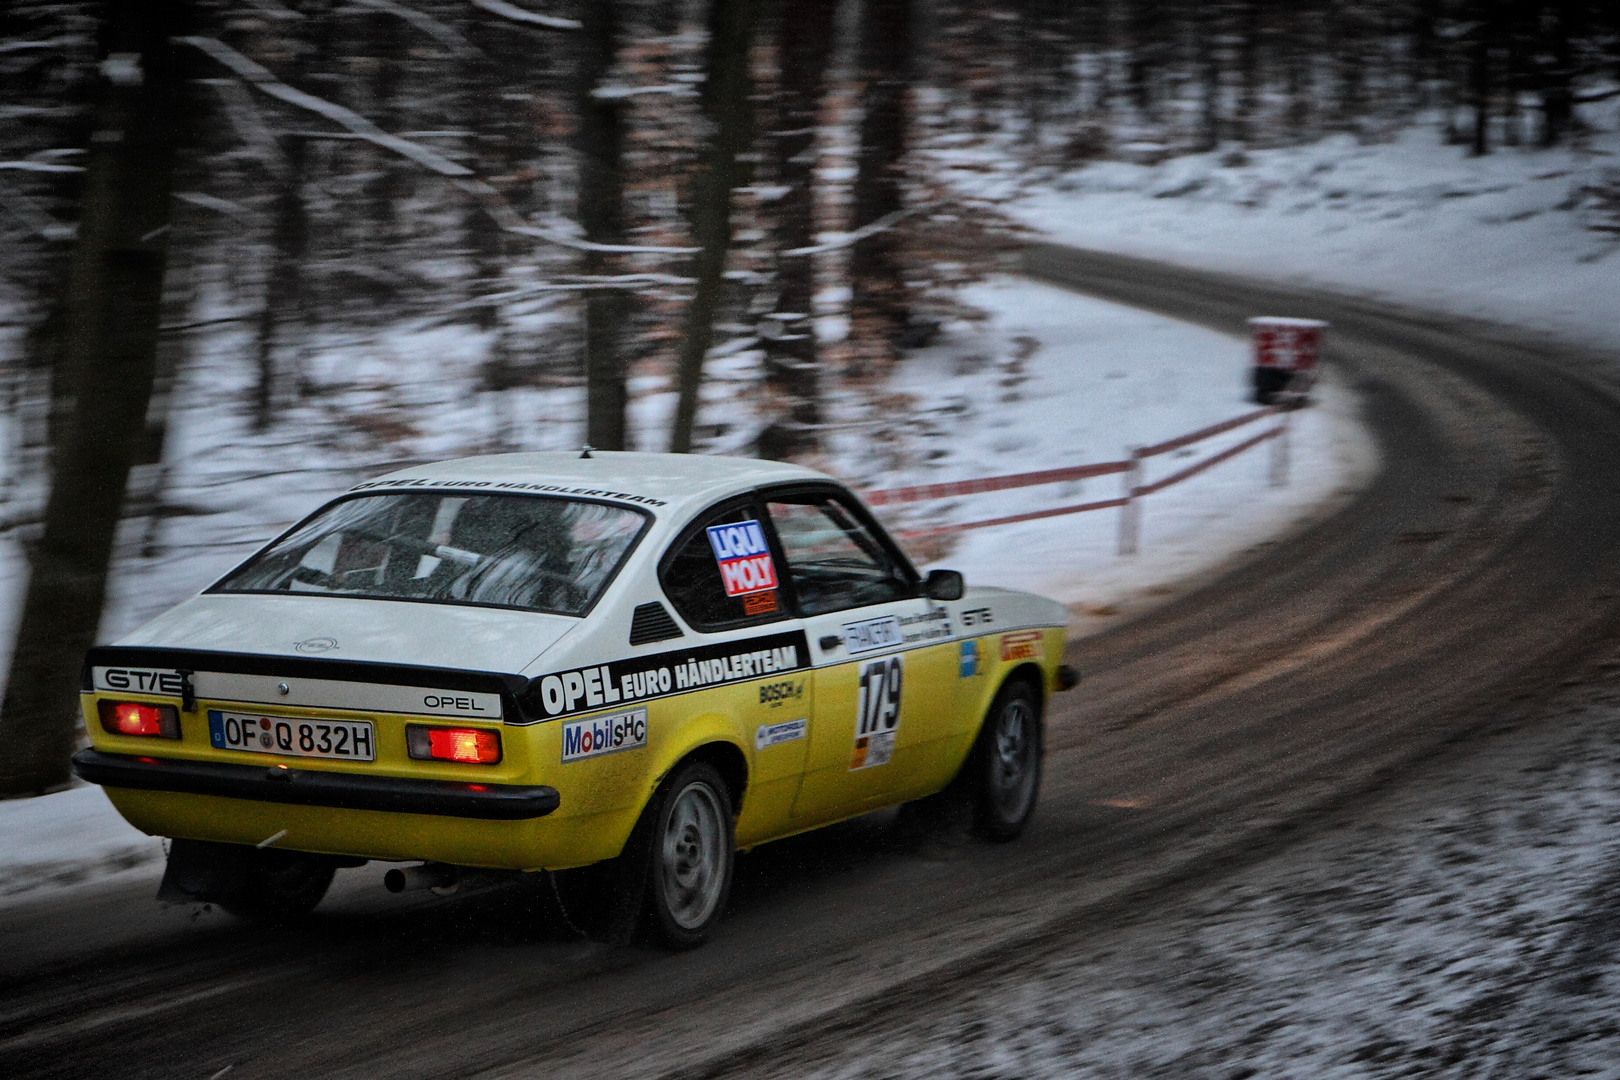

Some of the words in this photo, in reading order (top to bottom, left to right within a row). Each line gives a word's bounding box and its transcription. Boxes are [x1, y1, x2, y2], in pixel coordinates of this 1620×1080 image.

[350, 478, 429, 491] OPEL
[429, 480, 492, 488] EURO
[710, 524, 767, 558] LIQUI
[722, 556, 773, 592] MOLY
[105, 668, 183, 694] GT/E
[541, 665, 620, 715] OPEL
[621, 667, 672, 700] EURO
[674, 646, 798, 690] HÄNDLERTEAM
[859, 656, 902, 735] 179
[423, 695, 485, 711] OPEL
[226, 718, 256, 747] OF
[298, 723, 372, 756] 832H
[565, 719, 613, 756] Mobil
[613, 715, 644, 746] SHC
